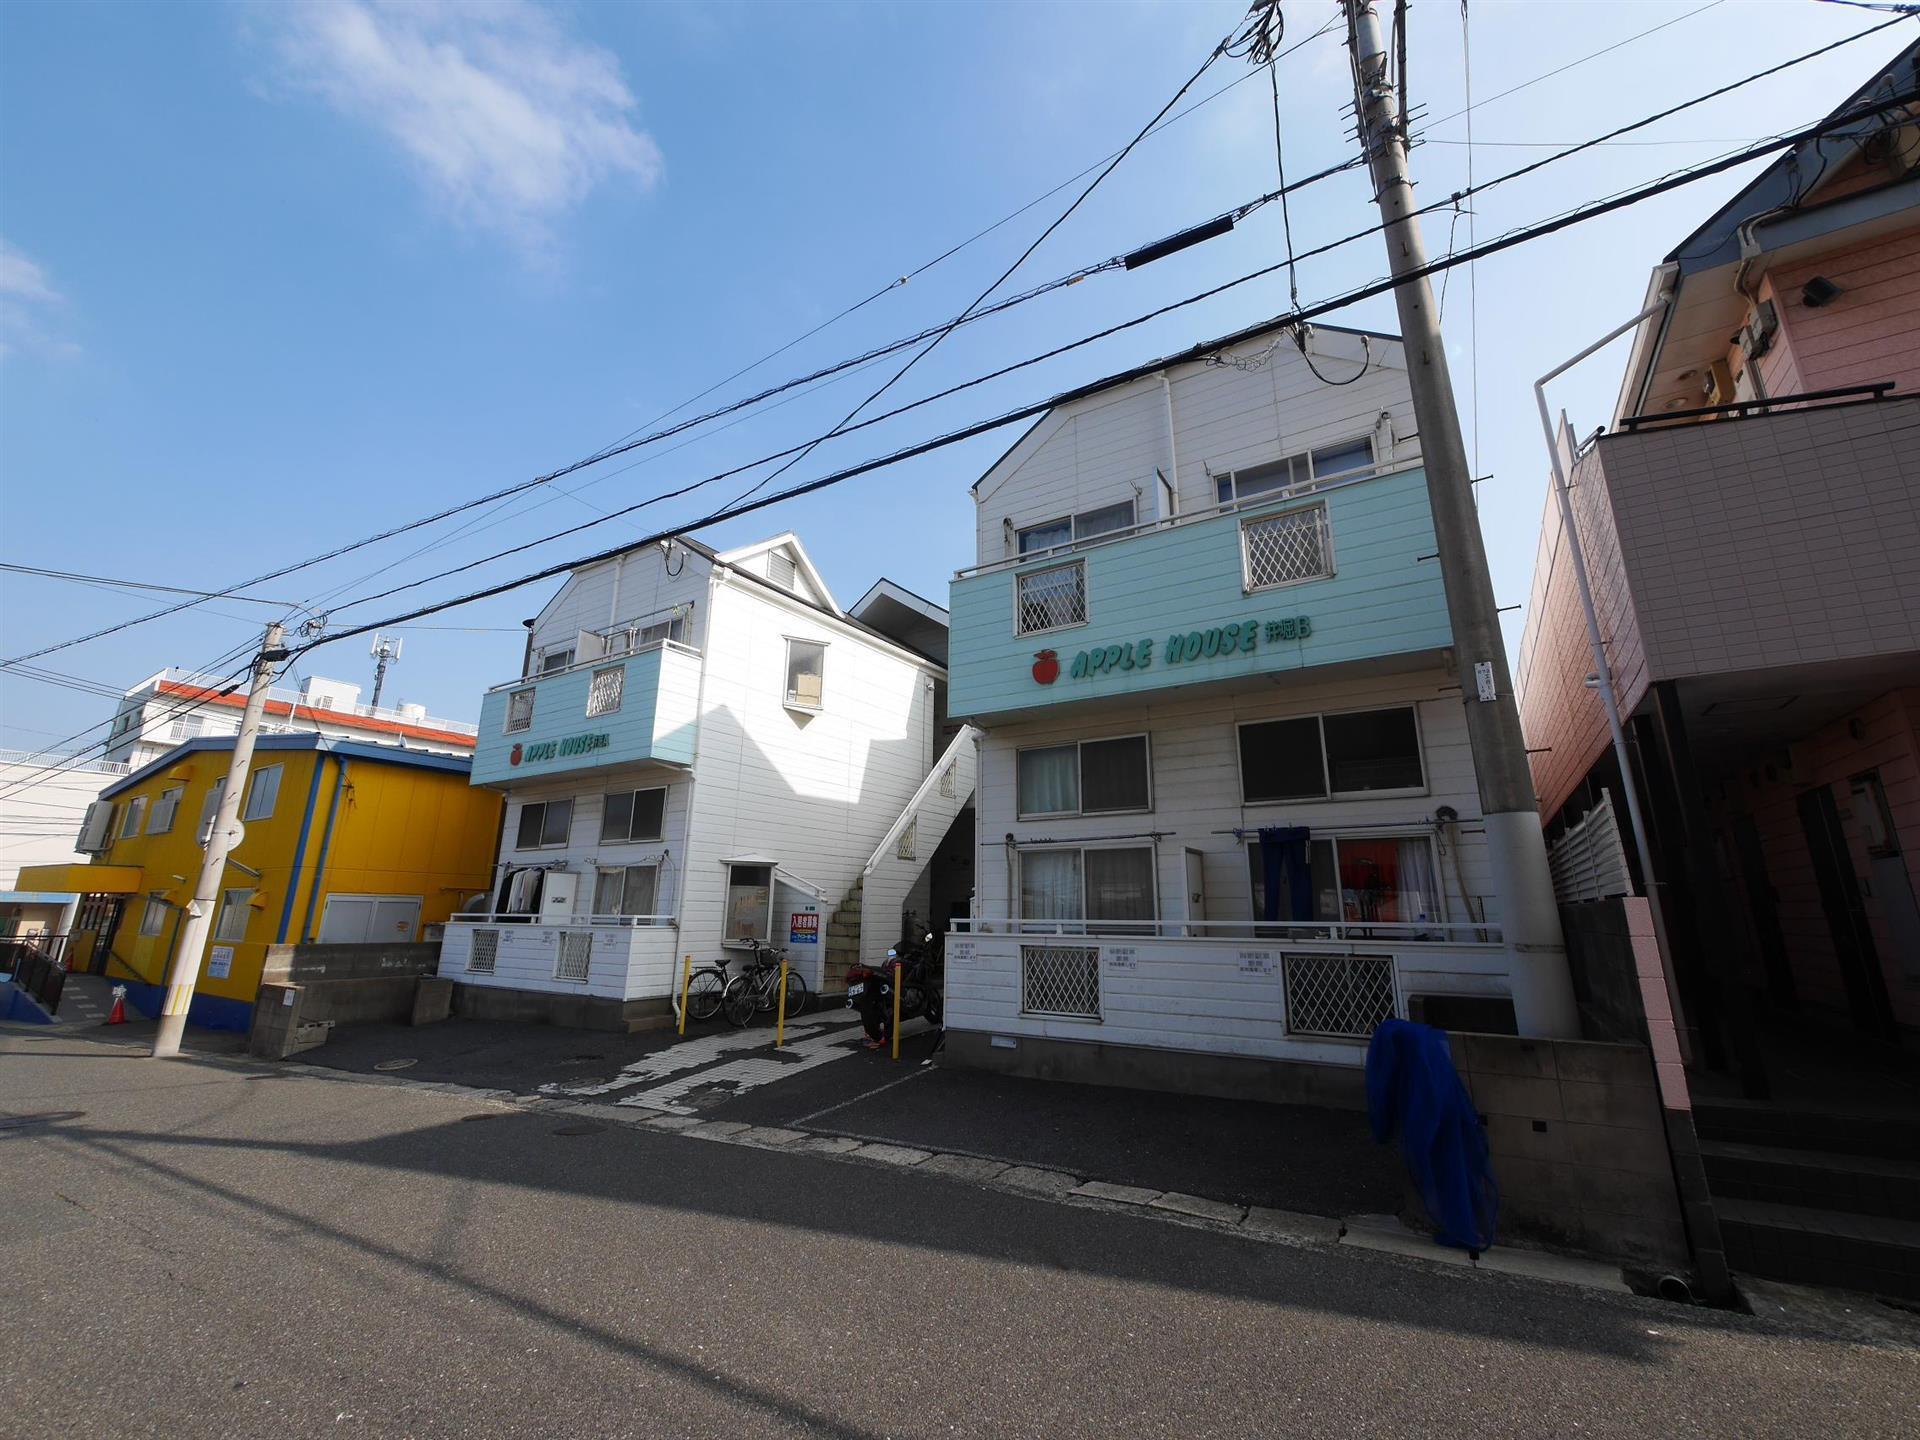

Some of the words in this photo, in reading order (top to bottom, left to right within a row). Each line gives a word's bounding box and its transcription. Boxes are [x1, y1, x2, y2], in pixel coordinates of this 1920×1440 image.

[1070, 638, 1153, 680] APPLE
[1165, 619, 1259, 665] HOUSE
[525, 741, 557, 762] APPLE
[559, 734, 594, 756] HOUSE
